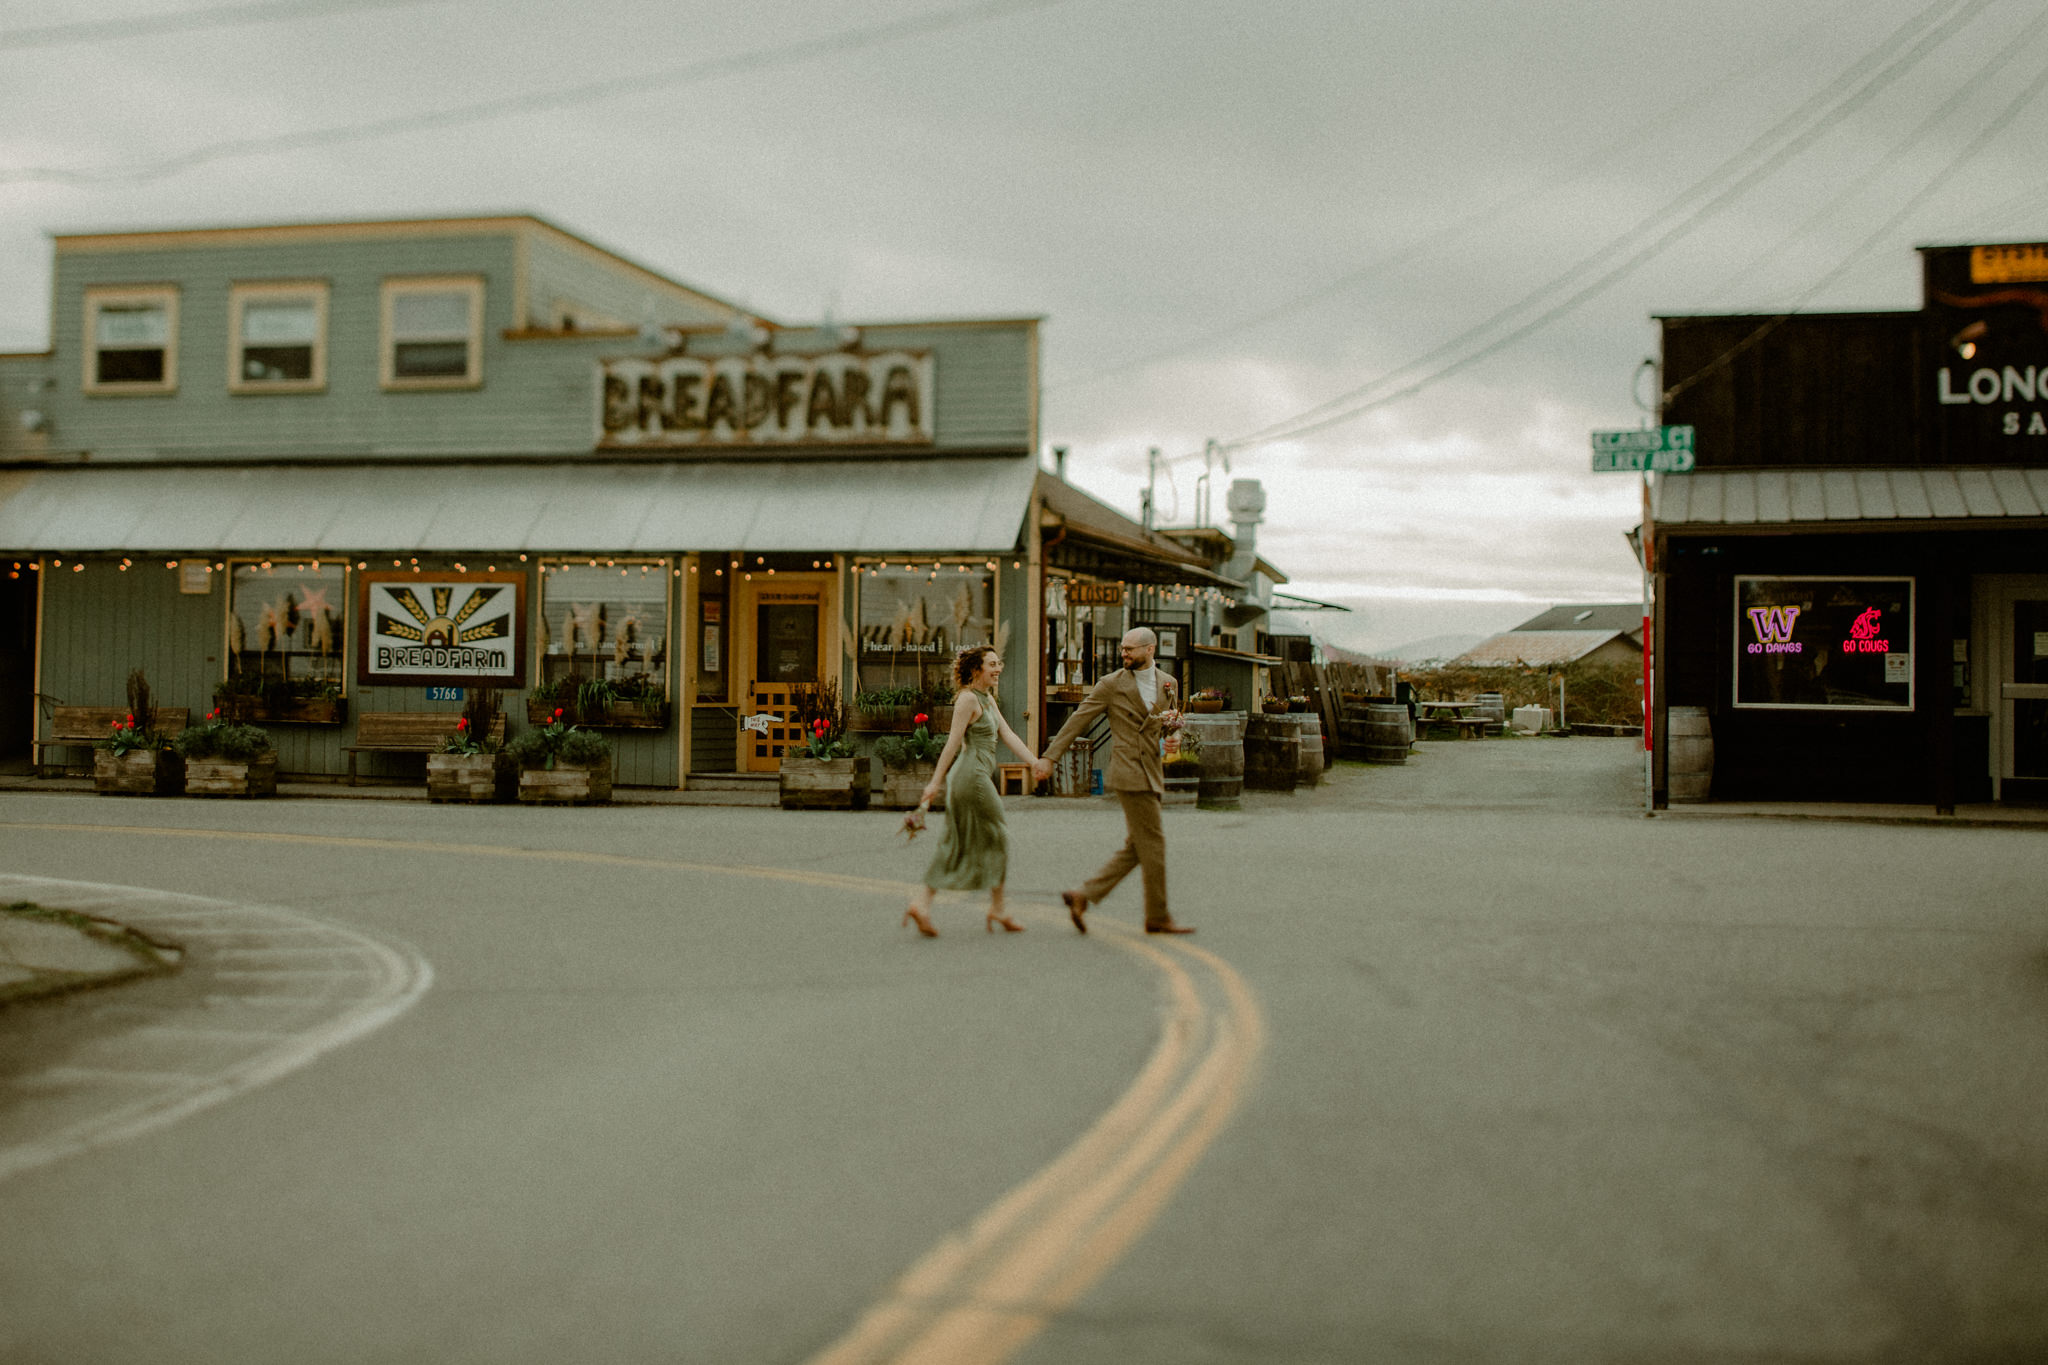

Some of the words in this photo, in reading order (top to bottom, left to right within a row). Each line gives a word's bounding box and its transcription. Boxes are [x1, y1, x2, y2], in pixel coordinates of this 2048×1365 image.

[1067, 585, 1119, 603] CLOSED
[870, 640, 936, 652] hear-baked
[1747, 643, 1763, 654] GO
[1765, 642, 1802, 653] DAWGS
[1842, 639, 1857, 653] GO
[1858, 639, 1889, 653] COUGS
[375, 646, 507, 670] BREADFARM
[432, 687, 457, 700] 5766
